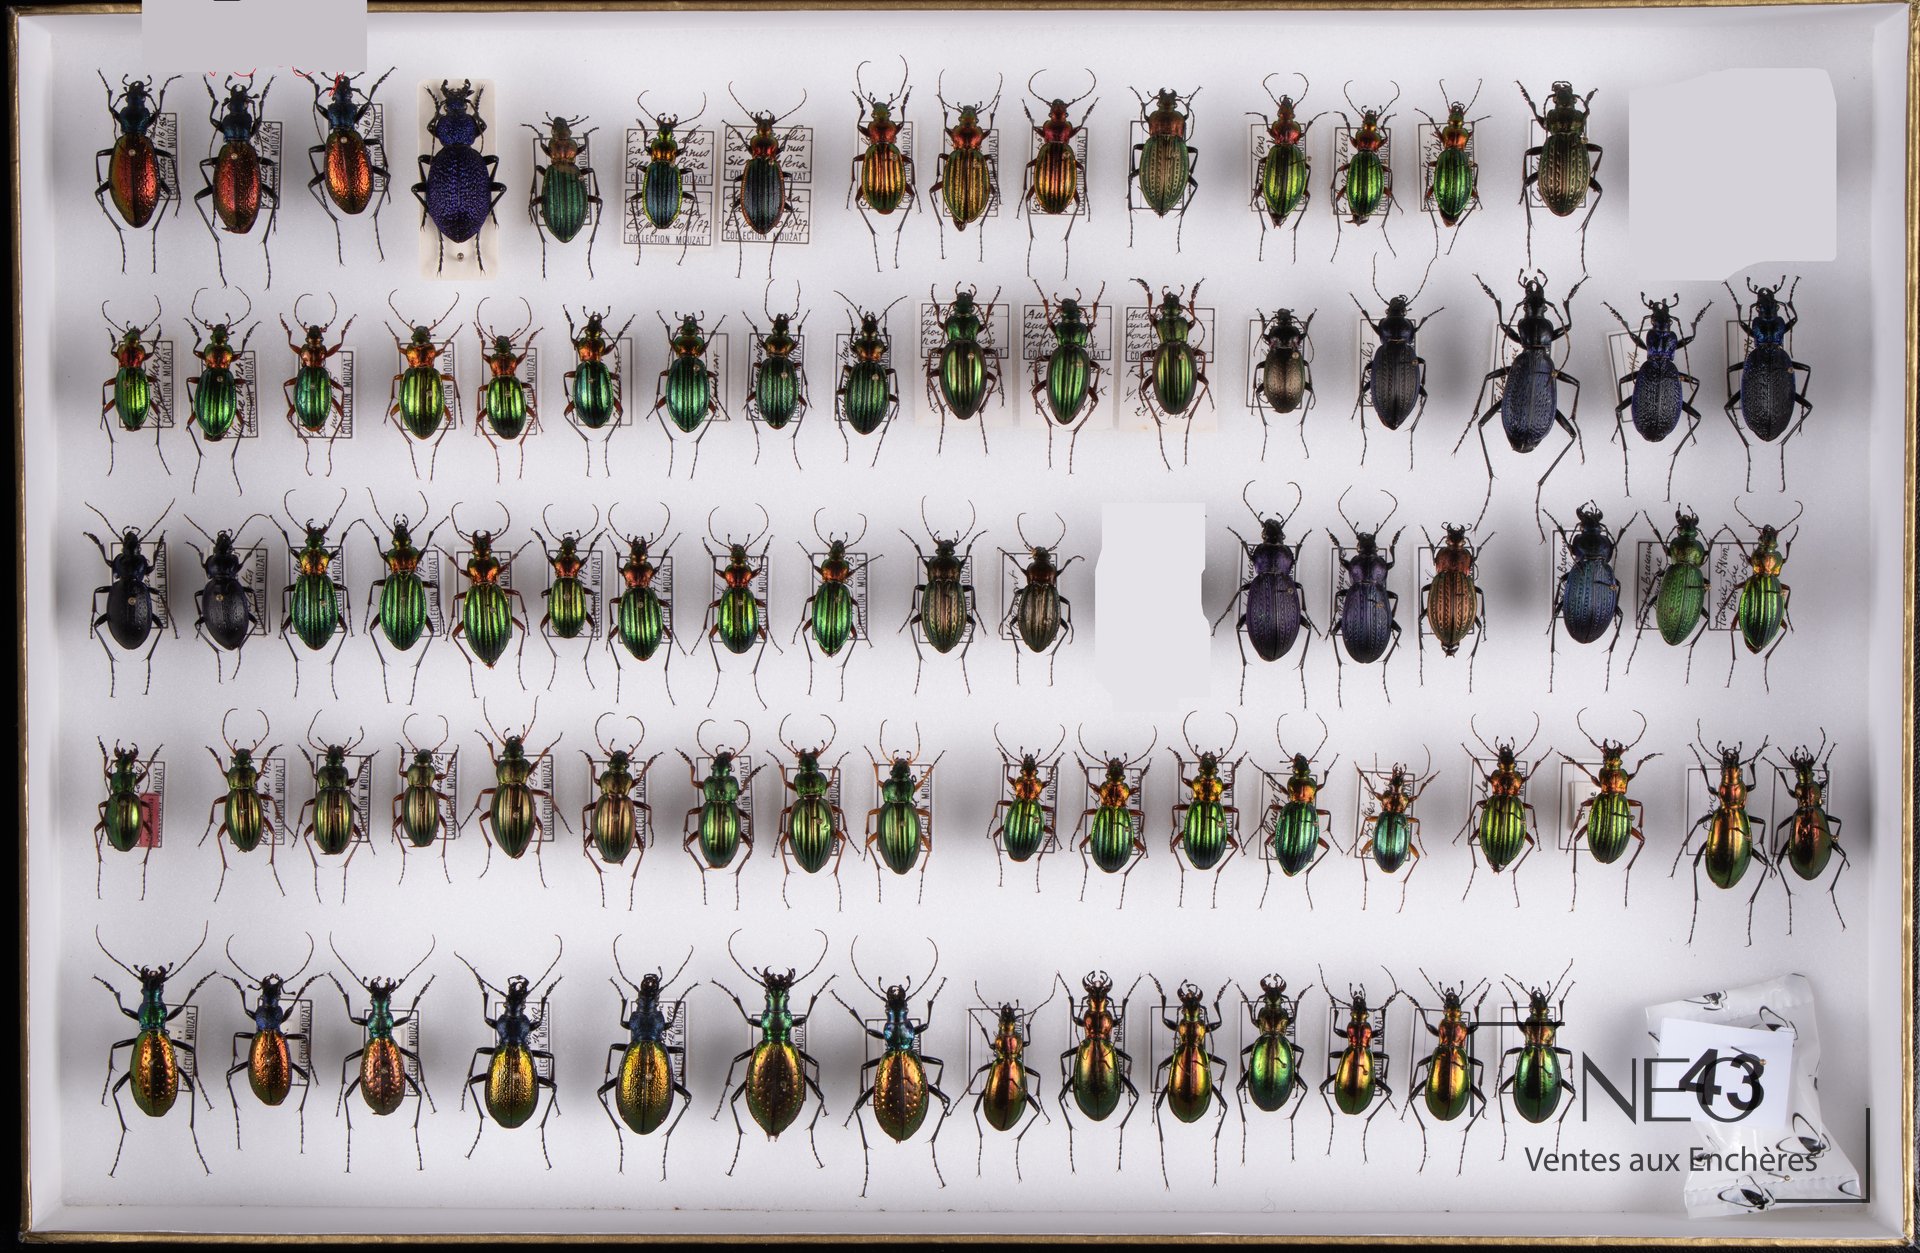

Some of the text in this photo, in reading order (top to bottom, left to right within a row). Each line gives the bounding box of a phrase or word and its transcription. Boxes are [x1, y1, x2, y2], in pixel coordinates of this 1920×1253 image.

[167, 119, 176, 148] MOUZAT
[271, 127, 280, 156] MOUZAT
[902, 127, 910, 156] MOUZAT
[1076, 135, 1086, 165] MOUZAT
[374, 147, 382, 188] COLCTION
[628, 234, 704, 245] COLLECTION MOUZAT
[726, 231, 766, 241] COLLECTION
[527, 354, 535, 383] MOUZAT
[162, 348, 172, 424] COLLECTION MOUZAT
[245, 357, 255, 432] COLLECTION MOUZAT
[342, 359, 352, 434] COLLECTION MOUZAT
[256, 554, 265, 583] MOUZAT
[500, 557, 509, 586] MOUAT
[591, 556, 600, 586] MOUZAT
[662, 563, 671, 592] MOUZAT
[961, 561, 970, 586] OUZAT
[857, 558, 866, 634] COLLECTION MOUZAT
[275, 765, 284, 793] MOUZAT
[542, 760, 552, 836] COLLECTION MOUZAT
[186, 1012, 195, 1040] MOUZAT
[301, 1005, 310, 1033] MOUZAT
[408, 1019, 417, 1047] MOUZAT
[675, 1007, 684, 1035] MOUZAT
[795, 1023, 804, 1049] MOUZA
[1678, 1048, 1765, 1111] 43
